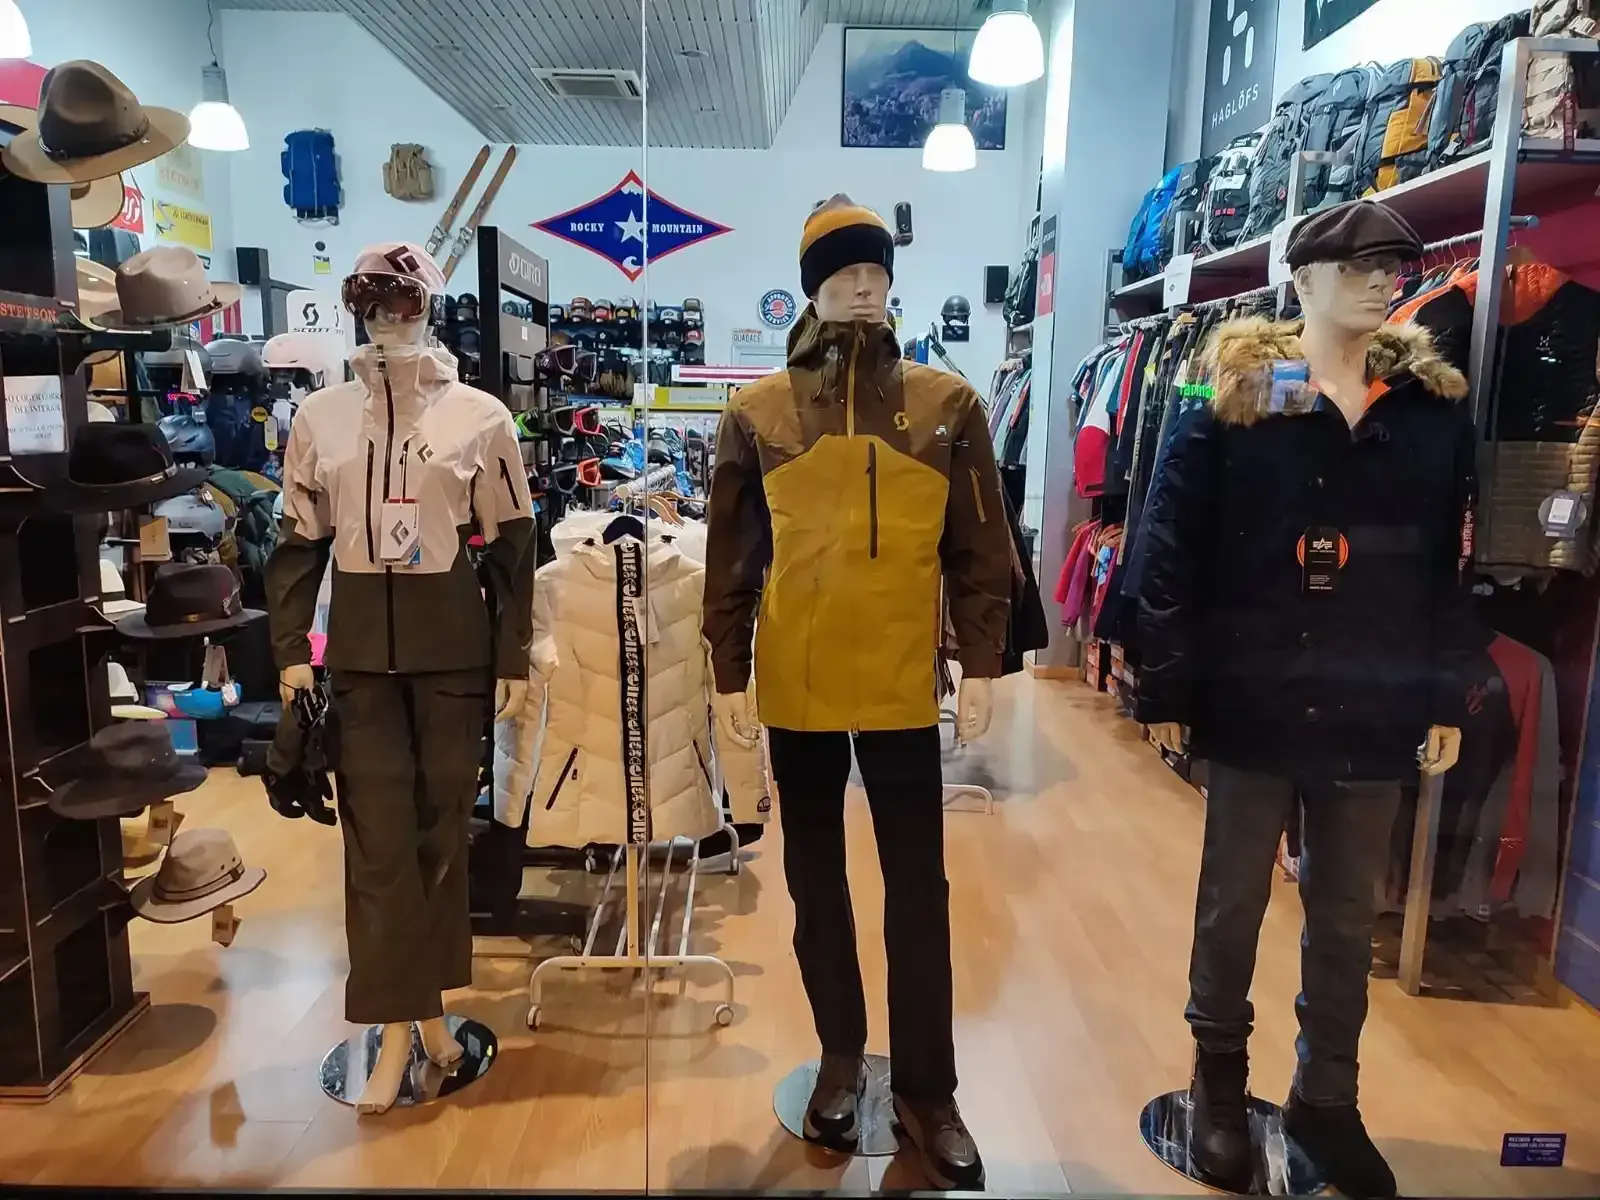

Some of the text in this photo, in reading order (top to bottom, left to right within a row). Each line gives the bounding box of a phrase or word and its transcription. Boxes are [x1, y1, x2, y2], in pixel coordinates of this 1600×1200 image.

[570, 222, 703, 234] ROCKY MOUNTAIN
[0, 302, 57, 323] STETSON
